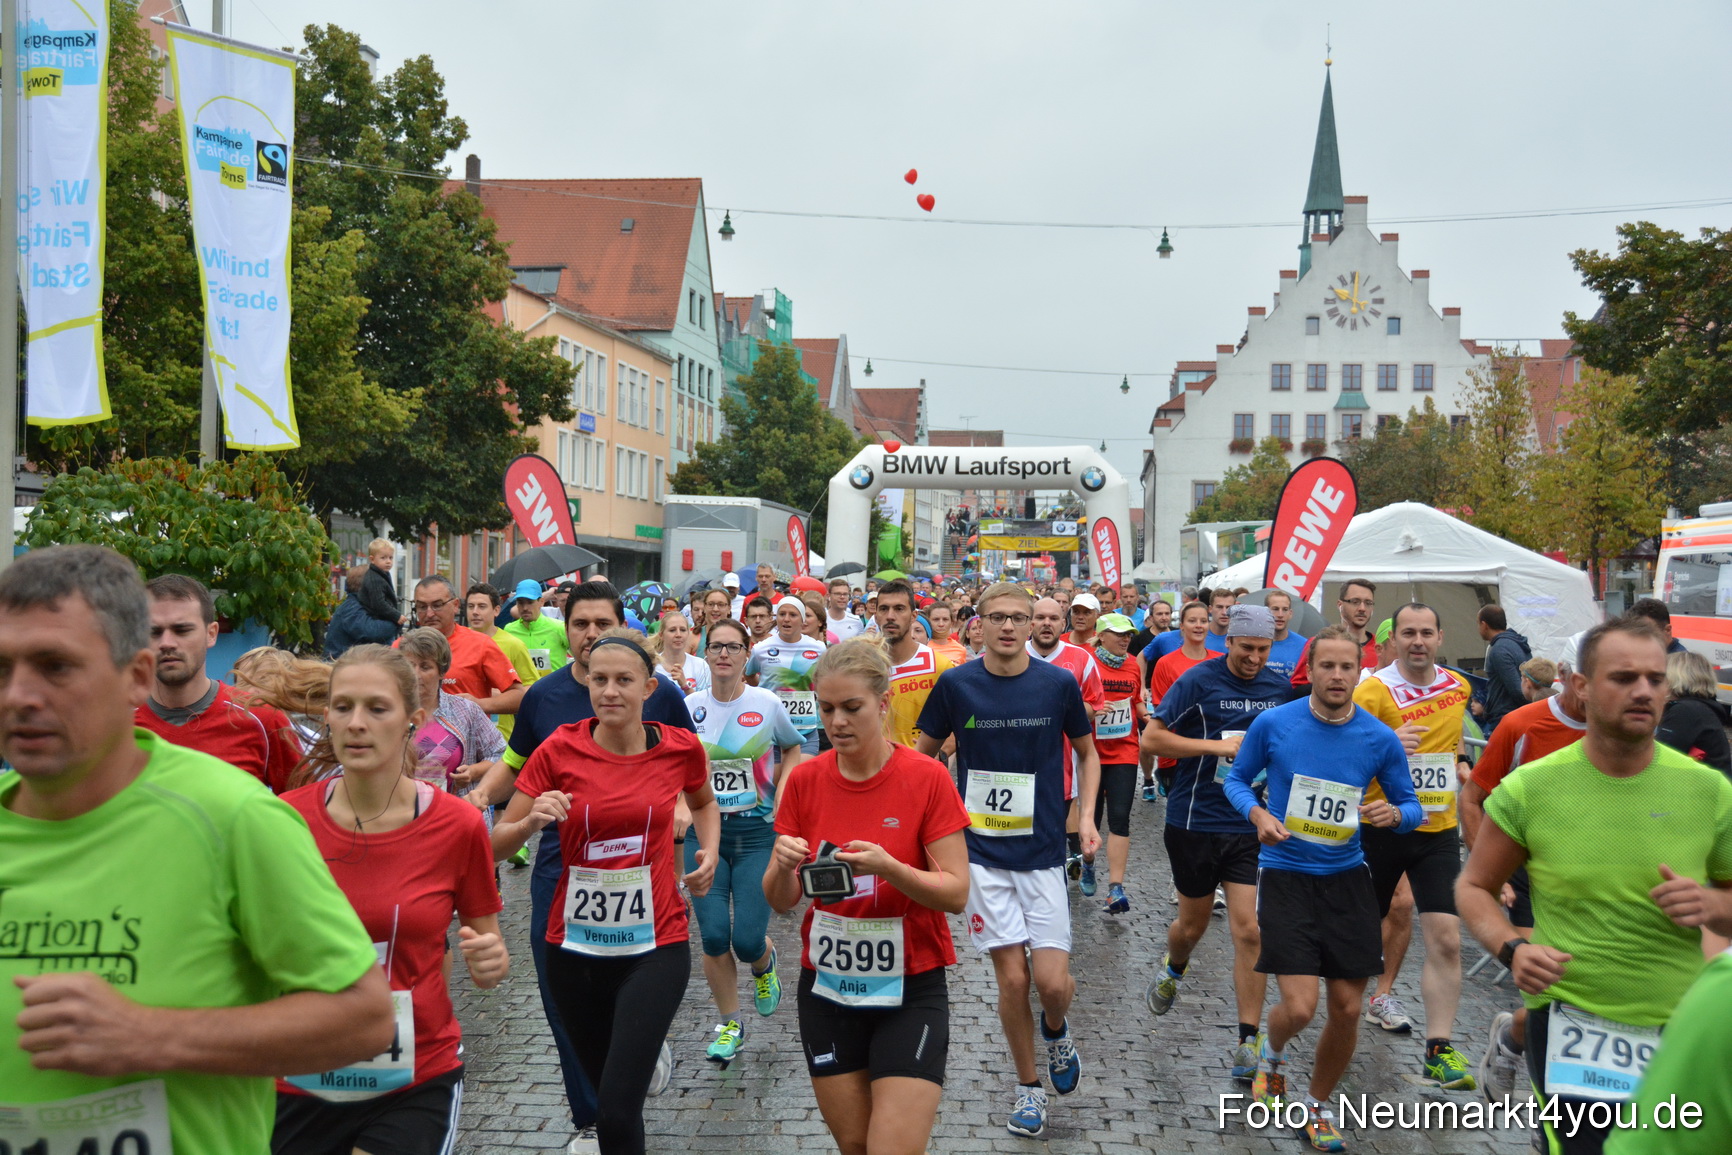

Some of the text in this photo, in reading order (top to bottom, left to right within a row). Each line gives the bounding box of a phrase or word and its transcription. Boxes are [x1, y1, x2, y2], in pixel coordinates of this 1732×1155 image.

[258, 174, 286, 185] FAIRTRADE
[882, 453, 1071, 480] BMW Laufsport
[1018, 539, 1040, 548] ZIEL
[1272, 477, 1345, 597] REWE
[1220, 700, 1244, 709] EURO
[1401, 691, 1467, 723] MAX BÖGL
[976, 717, 1051, 729] GOSSEN METRAWATT
[1100, 707, 1131, 725] 2774
[995, 774, 1028, 784] BOCK
[985, 788, 1012, 812] 42
[1306, 794, 1347, 823] 196
[985, 817, 1011, 828] Oliver
[1302, 823, 1338, 837] Bastian
[602, 843, 627, 853] DEHN
[602, 870, 643, 883] BOCK
[573, 889, 646, 922] 2374
[847, 921, 894, 932] BOCK
[584, 929, 634, 944] Veronika
[818, 935, 895, 972] 2599
[839, 979, 867, 995] Anja
[1561, 1026, 1656, 1073] 2799
[320, 1071, 378, 1088] Marina
[1583, 1069, 1630, 1091] Marco
